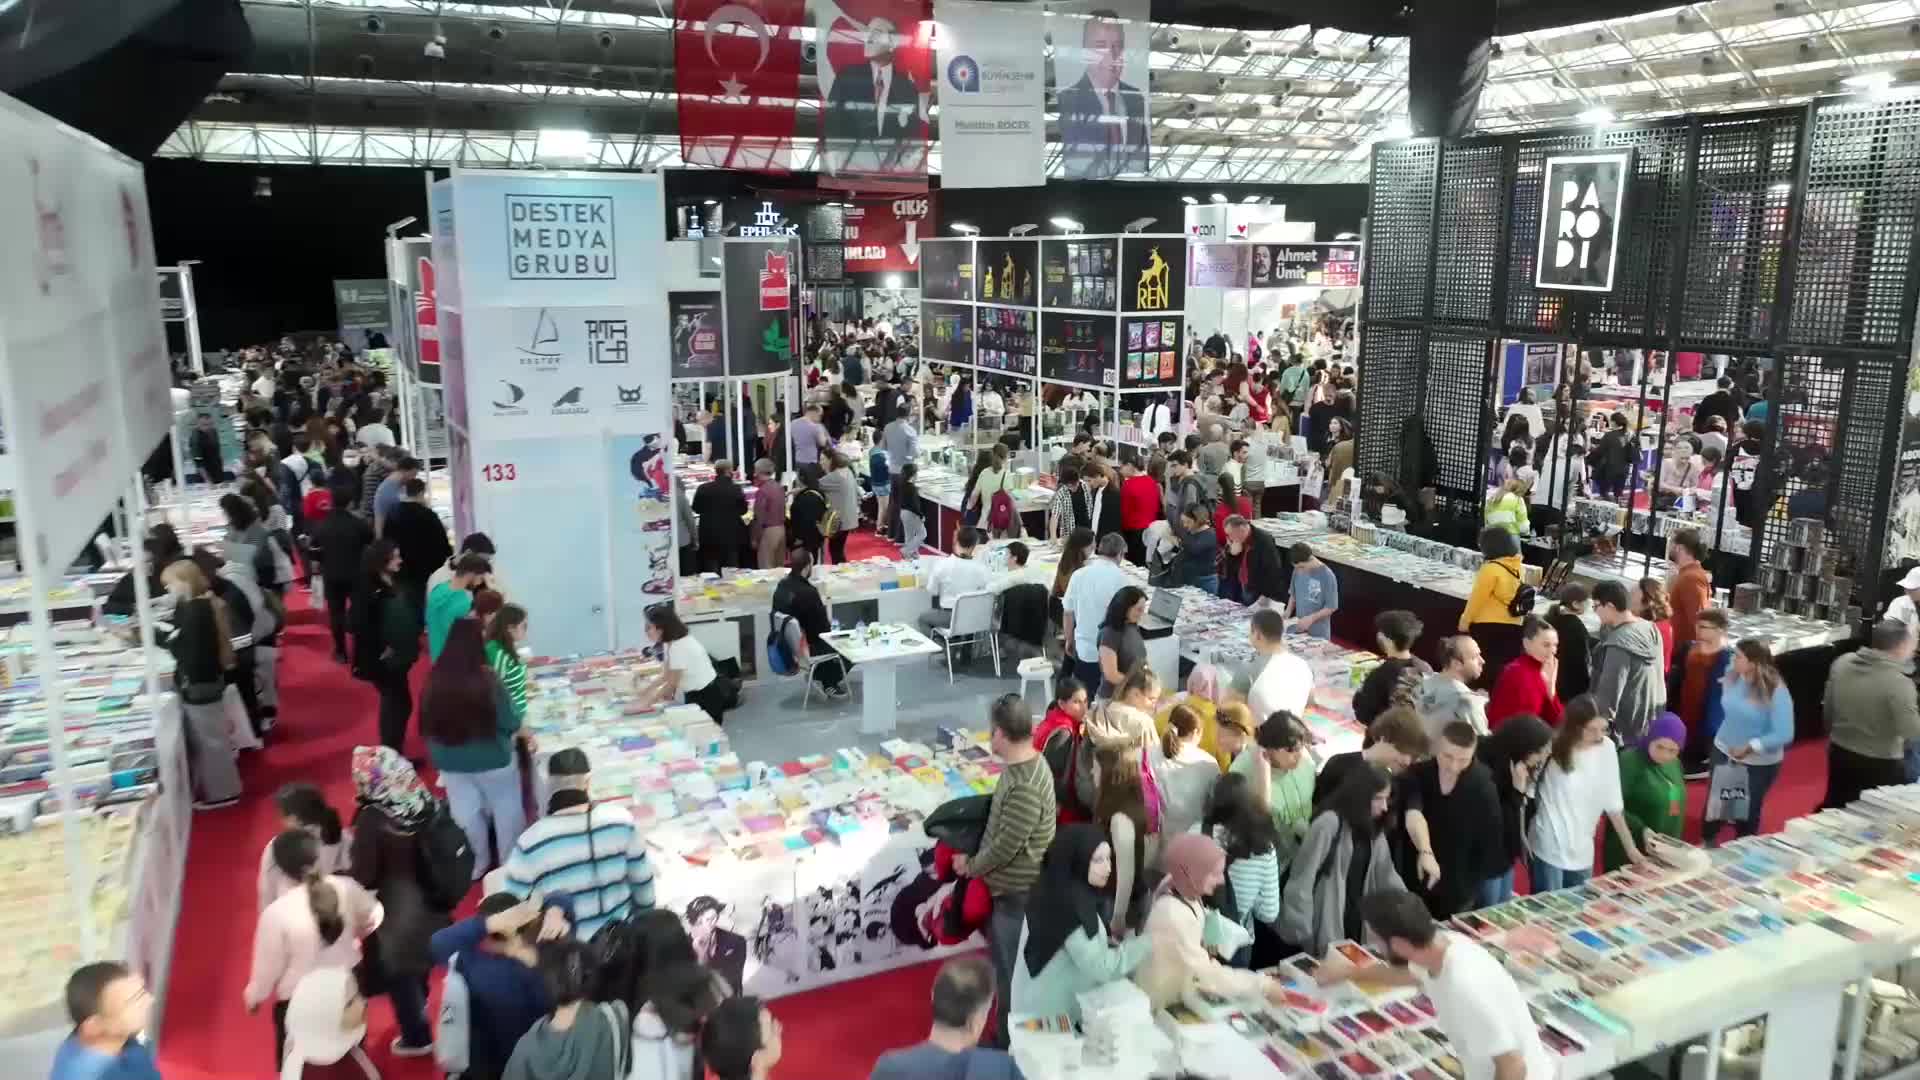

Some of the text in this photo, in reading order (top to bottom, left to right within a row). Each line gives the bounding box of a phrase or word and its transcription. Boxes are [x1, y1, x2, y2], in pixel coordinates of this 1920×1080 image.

[511, 202, 606, 225] DESTEK
[893, 199, 928, 220] ÇIKIŞ
[513, 228, 607, 249] MEDYA
[514, 254, 609, 274] GRUBU
[1276, 247, 1318, 262] Ahmet
[1276, 263, 1306, 280] Ümit
[1136, 288, 1169, 309] REN
[481, 463, 517, 482] 133
